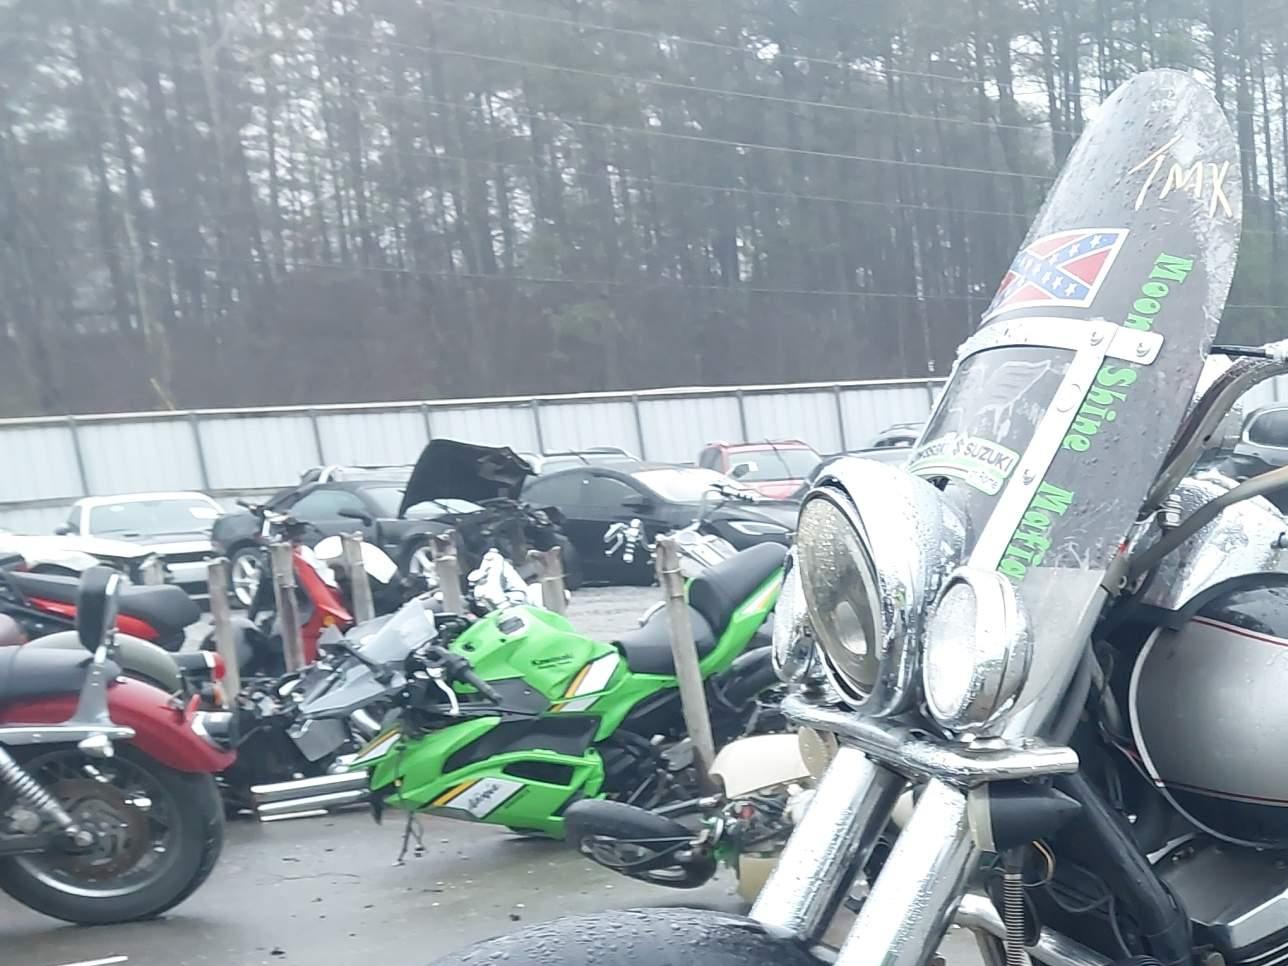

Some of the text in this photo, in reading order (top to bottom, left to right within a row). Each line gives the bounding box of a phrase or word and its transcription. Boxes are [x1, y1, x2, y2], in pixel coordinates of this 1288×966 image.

[963, 441, 1014, 472] SUZUKI
[998, 252, 1194, 580] Moon Shine Mafia
